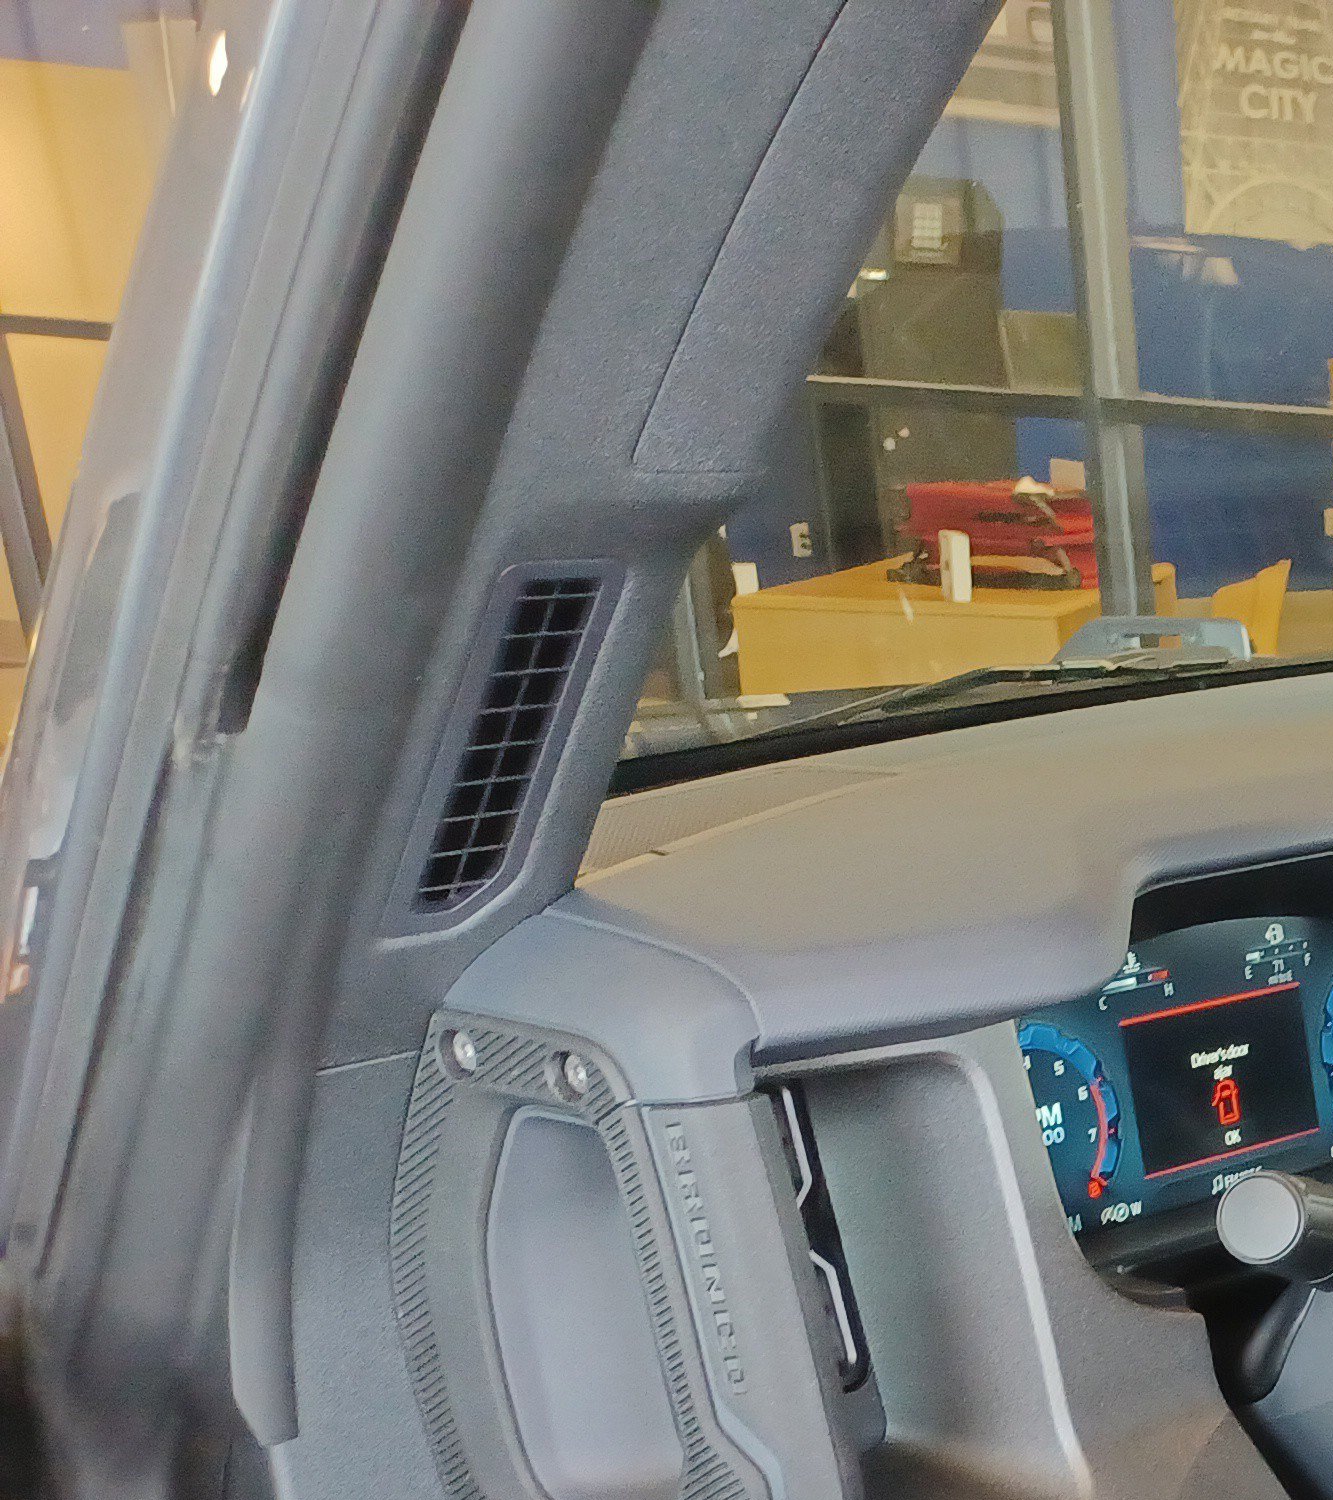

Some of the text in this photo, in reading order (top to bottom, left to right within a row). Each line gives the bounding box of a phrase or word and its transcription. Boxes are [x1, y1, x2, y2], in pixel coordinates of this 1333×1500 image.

[1239, 83, 1319, 123] CITY
[1053, 1059, 1065, 1077] 5
[1077, 1085, 1088, 1101] 6
[1087, 1126, 1098, 1143] 7
[665, 1121, 747, 1395] BRONCO
